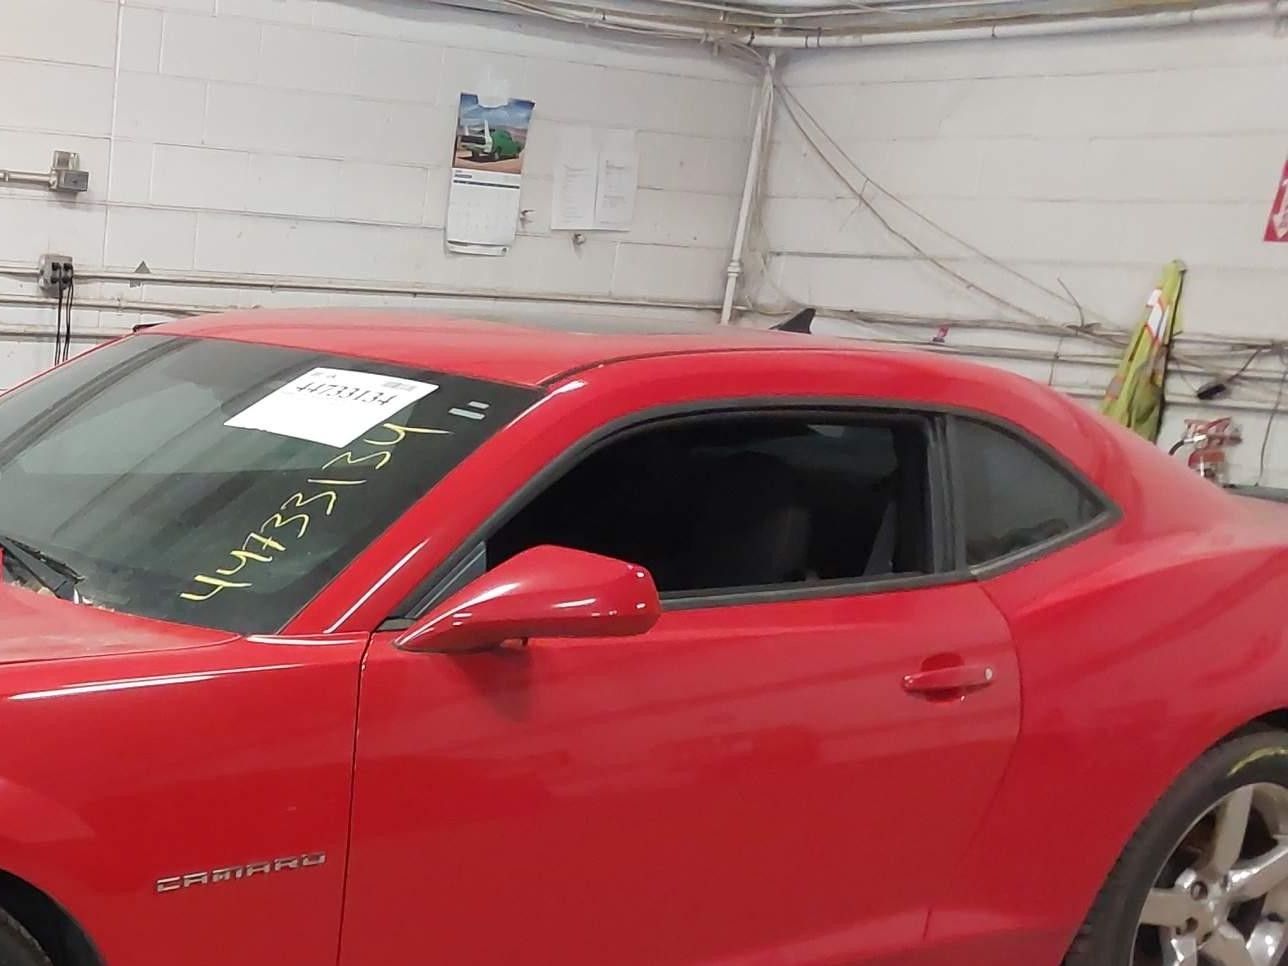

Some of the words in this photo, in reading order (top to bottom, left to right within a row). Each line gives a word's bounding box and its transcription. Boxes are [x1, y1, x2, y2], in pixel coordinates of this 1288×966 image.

[296, 381, 398, 406] 44733134
[180, 422, 452, 602] 44733134
[155, 851, 327, 892] CAMARO
